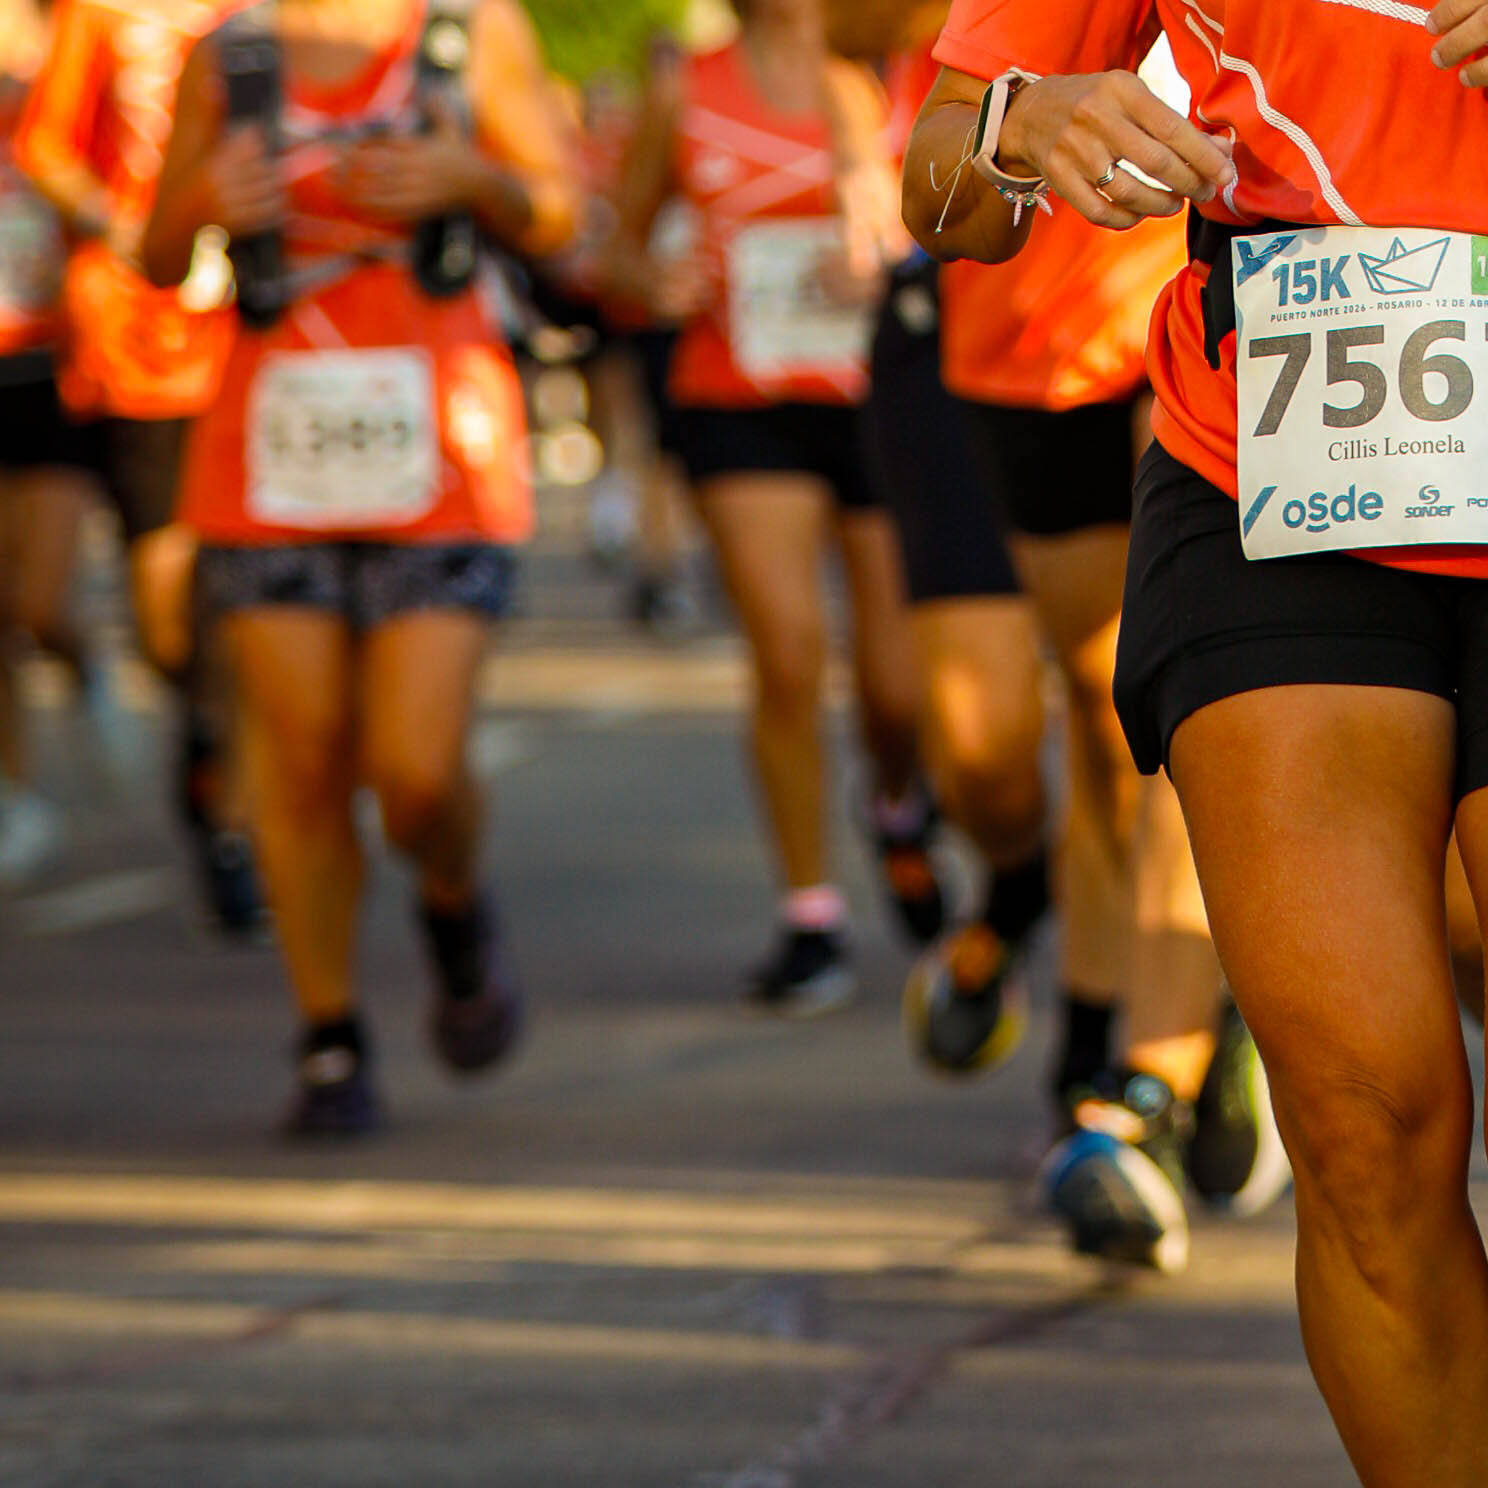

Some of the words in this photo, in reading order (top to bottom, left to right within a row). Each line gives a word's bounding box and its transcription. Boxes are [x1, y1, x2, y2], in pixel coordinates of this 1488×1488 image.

[1271, 254, 1352, 307] 15K
[1270, 311, 1307, 323] PUERTO
[1310, 307, 1341, 318] NORTE
[1343, 303, 1367, 314] 2026
[1377, 299, 1423, 311] ROSARIO
[1436, 298, 1447, 308] 12
[1451, 298, 1465, 308] DE
[1328, 438, 1378, 461] Cillis
[1383, 435, 1465, 458] Leonela
[1282, 483, 1384, 524] osde
